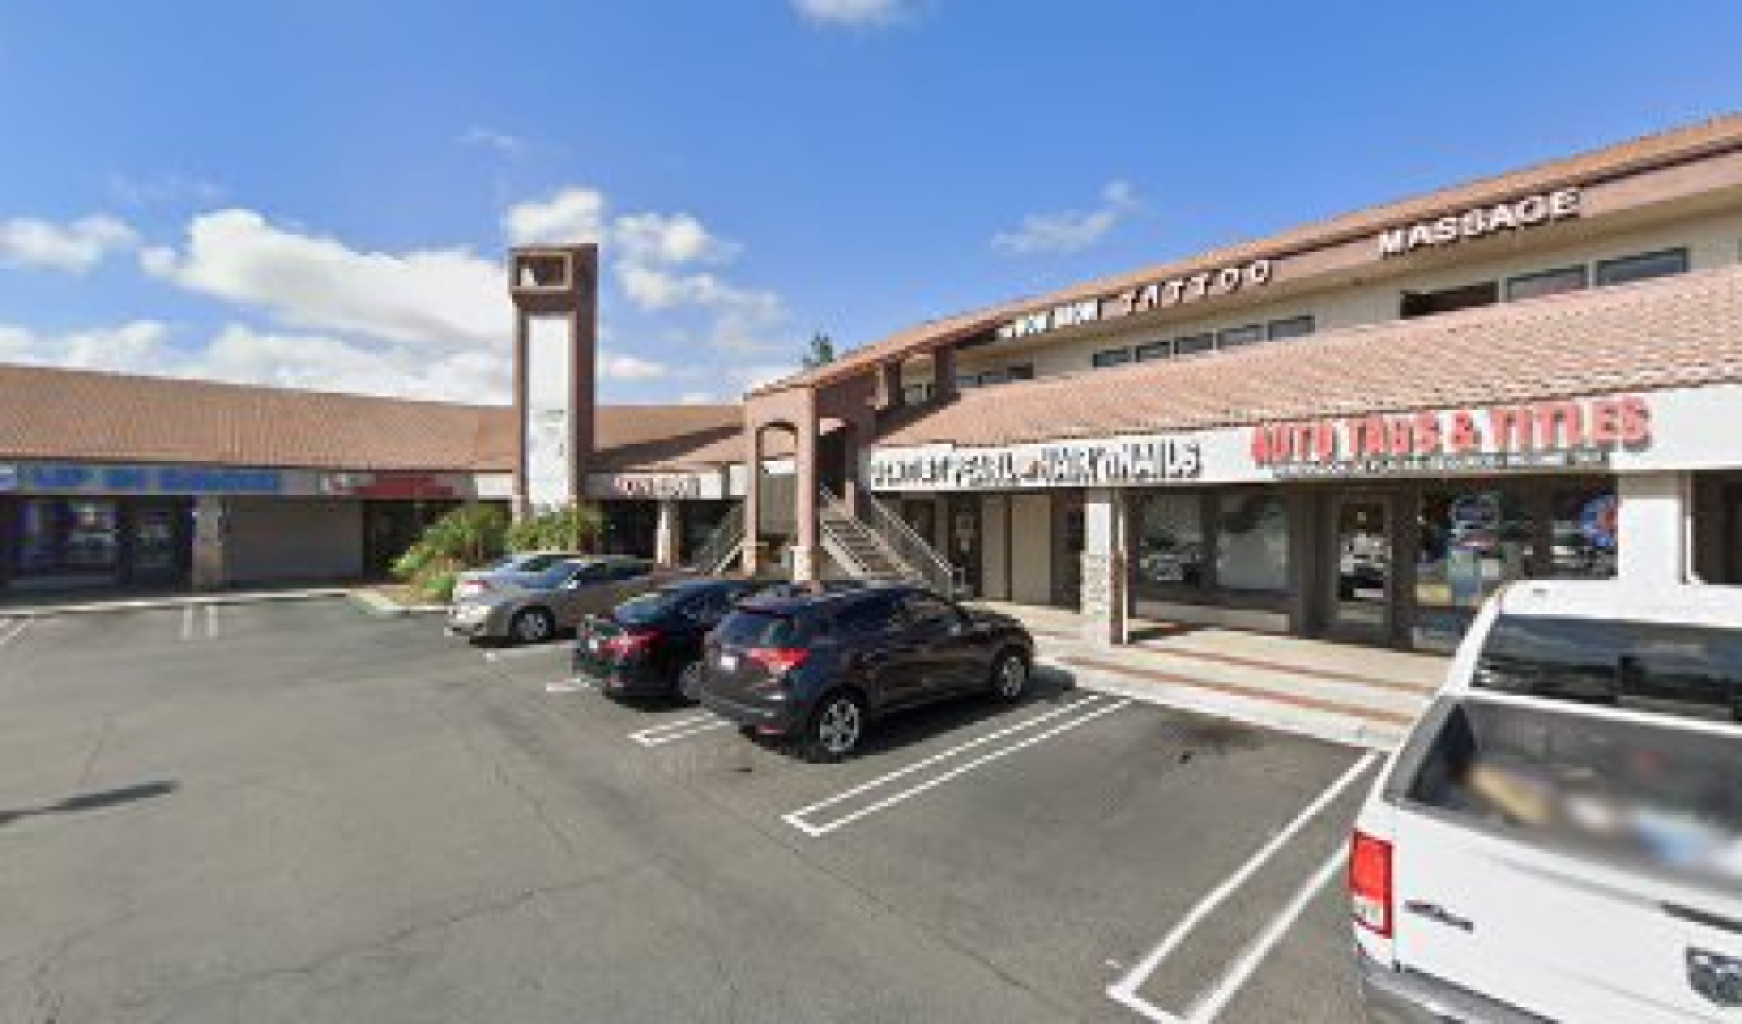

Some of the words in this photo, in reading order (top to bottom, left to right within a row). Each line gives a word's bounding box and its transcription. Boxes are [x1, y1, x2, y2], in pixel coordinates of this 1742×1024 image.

[1377, 187, 1581, 257] MASSAGE
[1120, 259, 1272, 313] TATTOO
[1251, 421, 1337, 464] AUTO
[1450, 409, 1480, 454] &
[1490, 396, 1652, 455] TITLES
